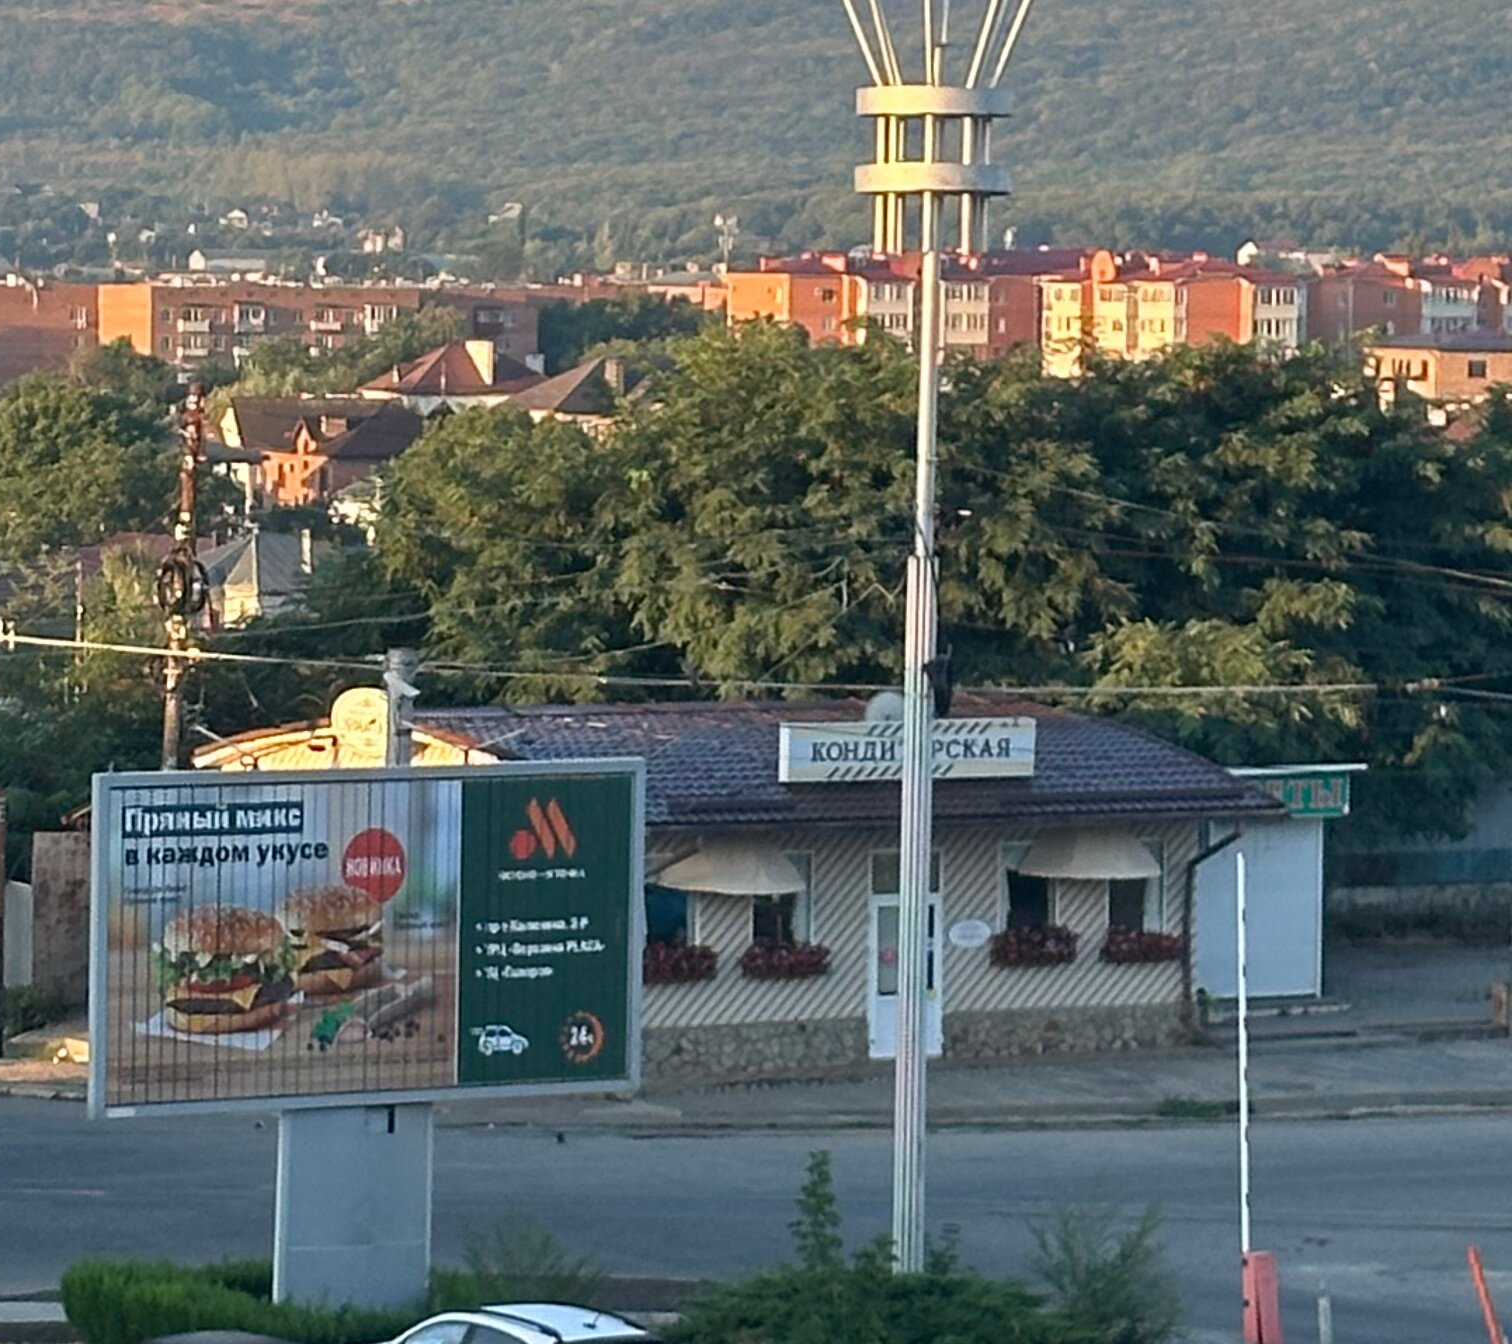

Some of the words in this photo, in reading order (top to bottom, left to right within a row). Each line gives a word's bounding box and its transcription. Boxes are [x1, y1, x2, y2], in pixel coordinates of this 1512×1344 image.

[810, 737, 1011, 761] КОНДИРСКАЯ
[124, 805, 230, 836] Пряный
[236, 807, 302, 829] микс
[126, 848, 139, 866] в
[146, 844, 250, 867] каждом
[257, 842, 329, 867] укусе
